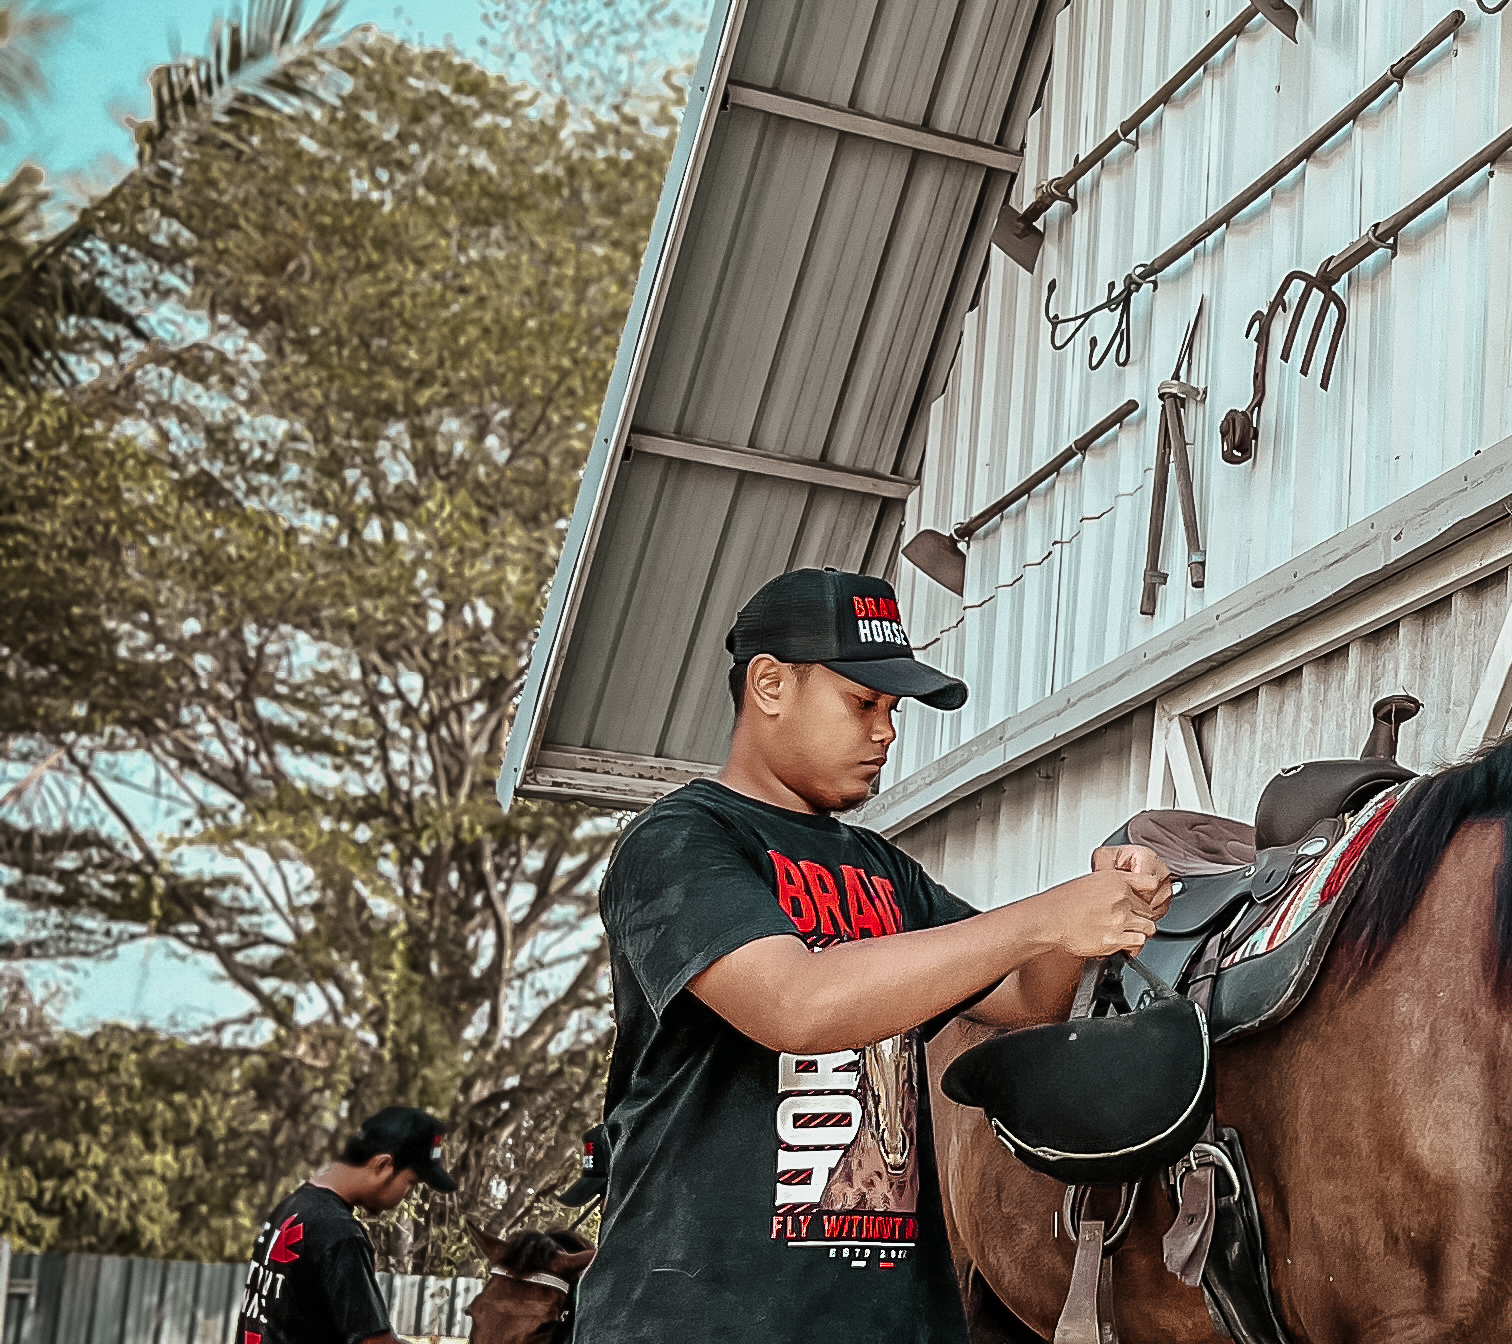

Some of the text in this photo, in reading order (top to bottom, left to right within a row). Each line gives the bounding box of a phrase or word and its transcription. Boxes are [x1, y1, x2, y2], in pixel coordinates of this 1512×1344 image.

[774, 1048, 863, 1207] HOR
[770, 1215, 811, 1239] FLY
[822, 1215, 902, 1239] WITHOUT
